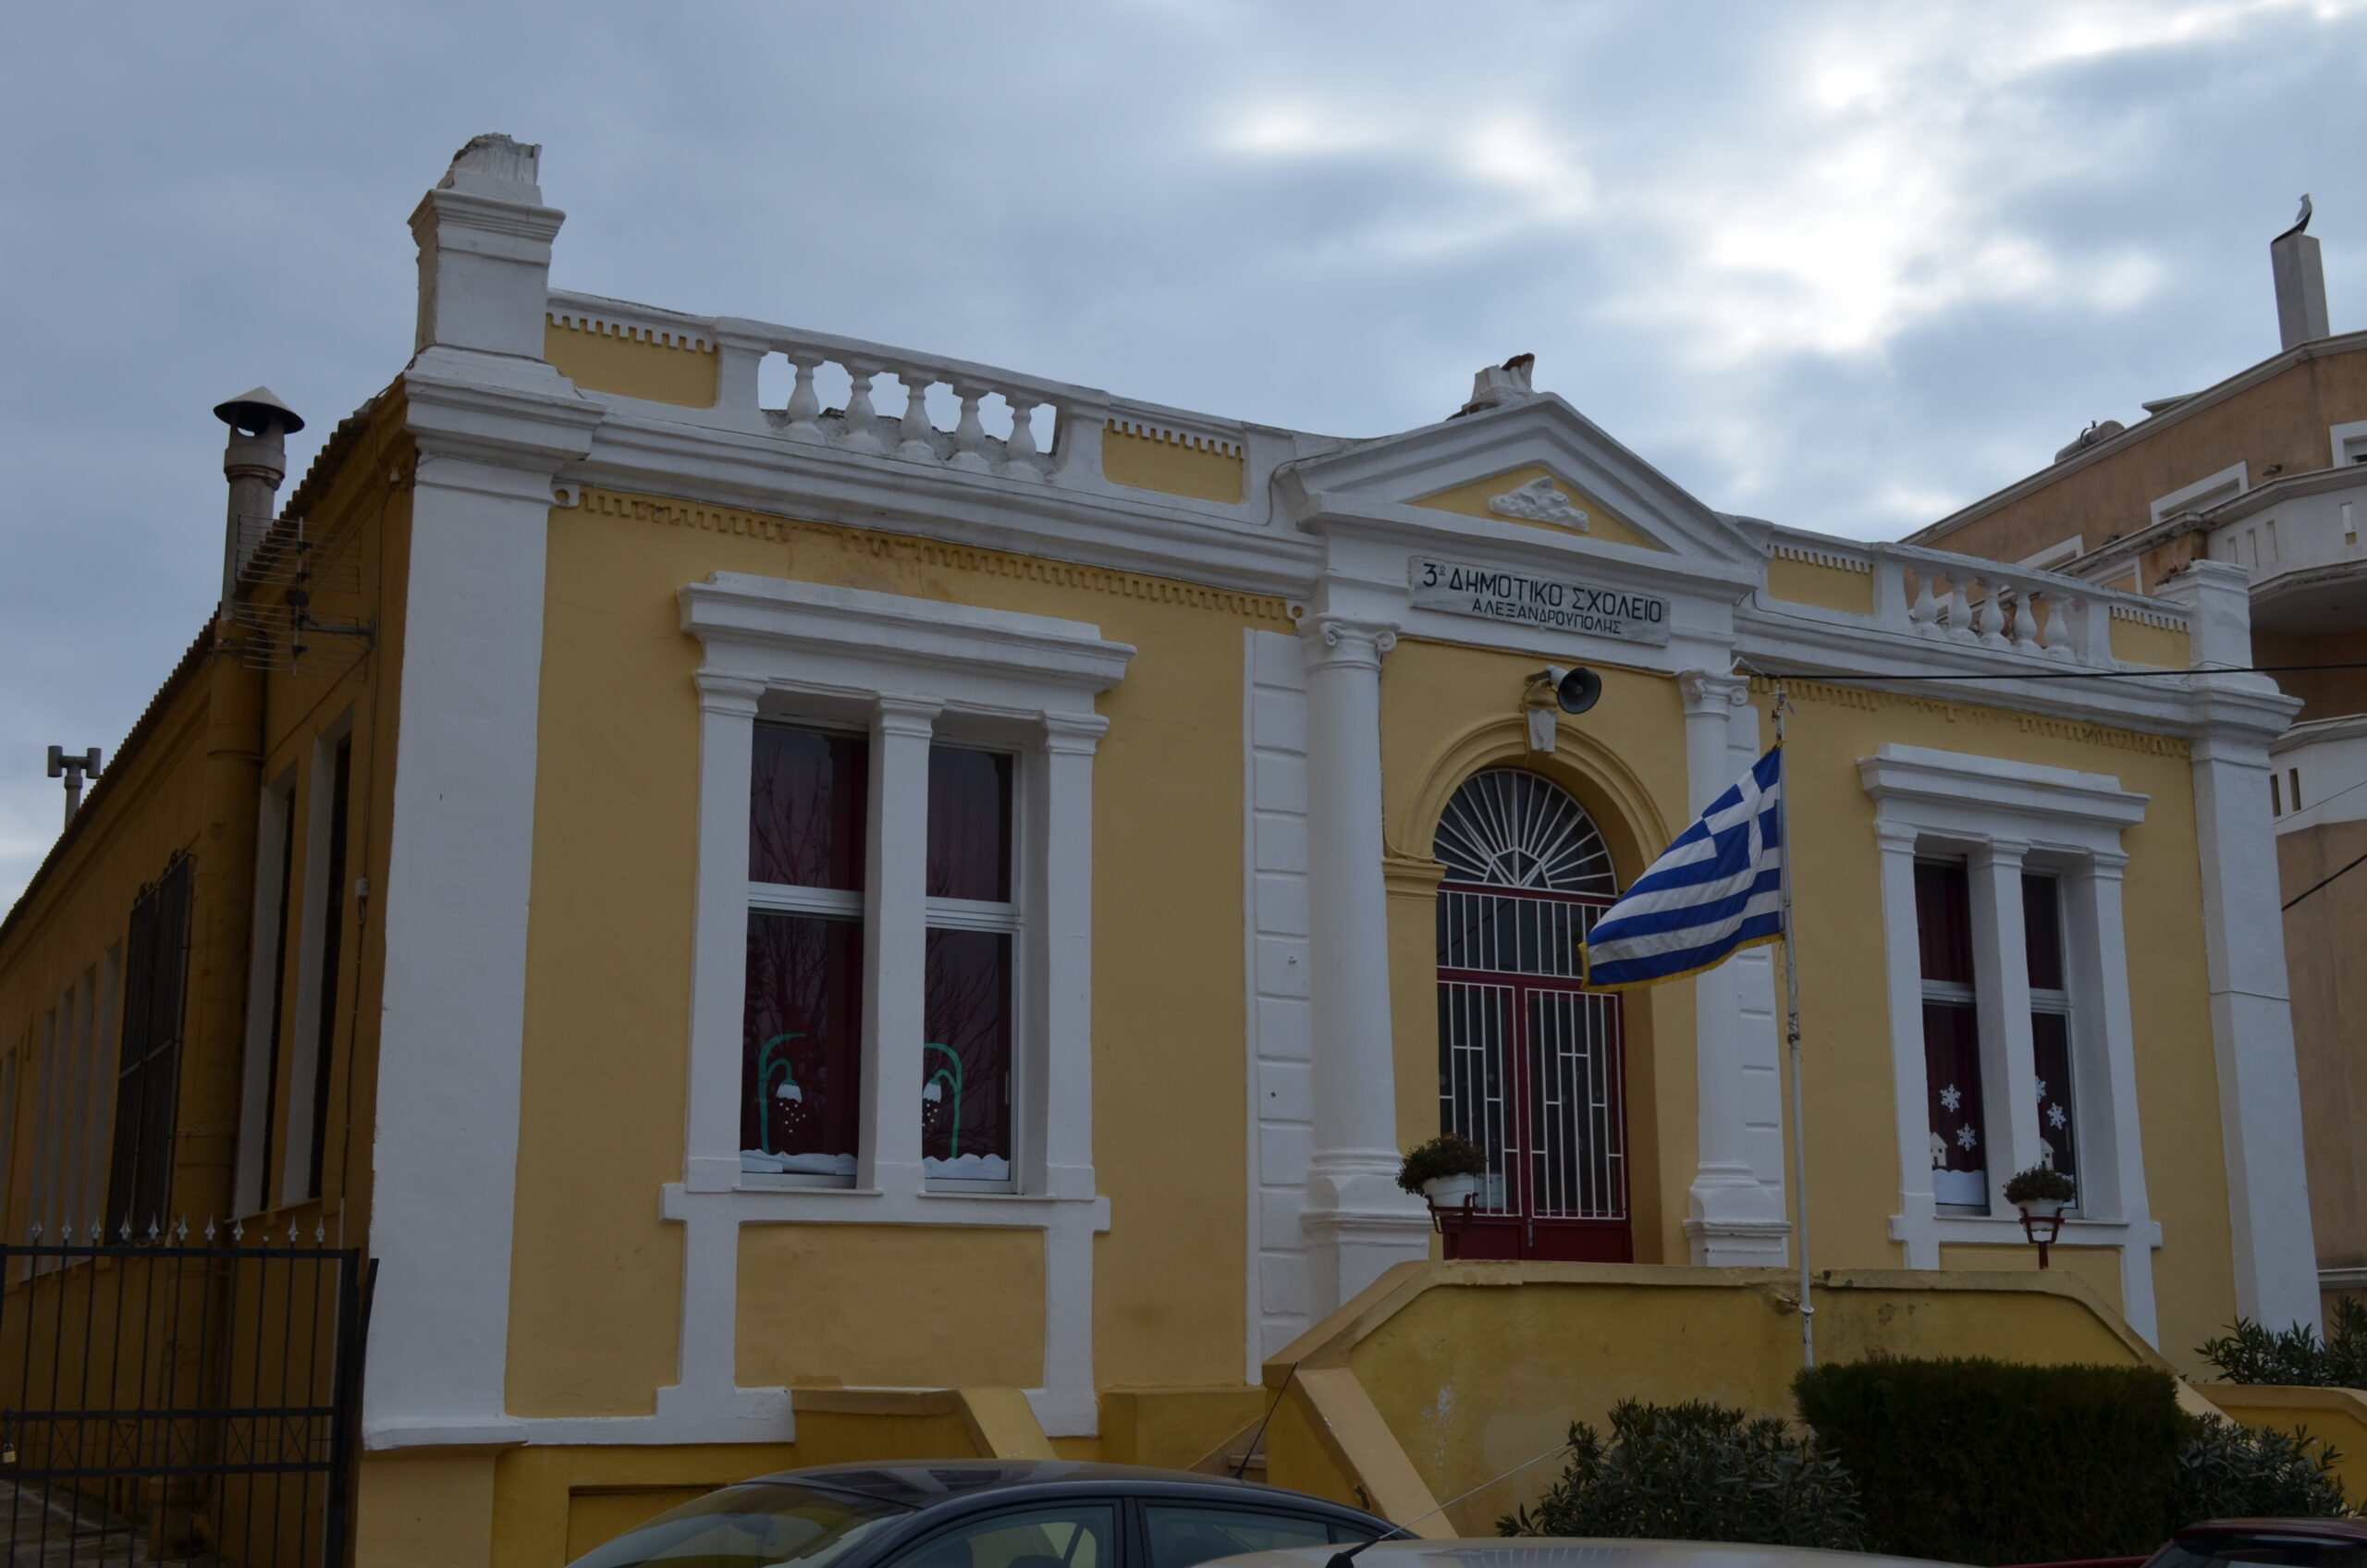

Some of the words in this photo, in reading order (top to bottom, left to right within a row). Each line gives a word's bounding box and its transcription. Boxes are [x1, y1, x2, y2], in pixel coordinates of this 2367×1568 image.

[1449, 568, 1563, 606] ΔΗΜΟΤΙΚΟ
[1572, 588, 1662, 623] ΣΧΟΛΕΙΟ
[1472, 598, 1622, 634] ΑΛΕΞΑΝΔΡΟΥΠΟΛΗΣ
